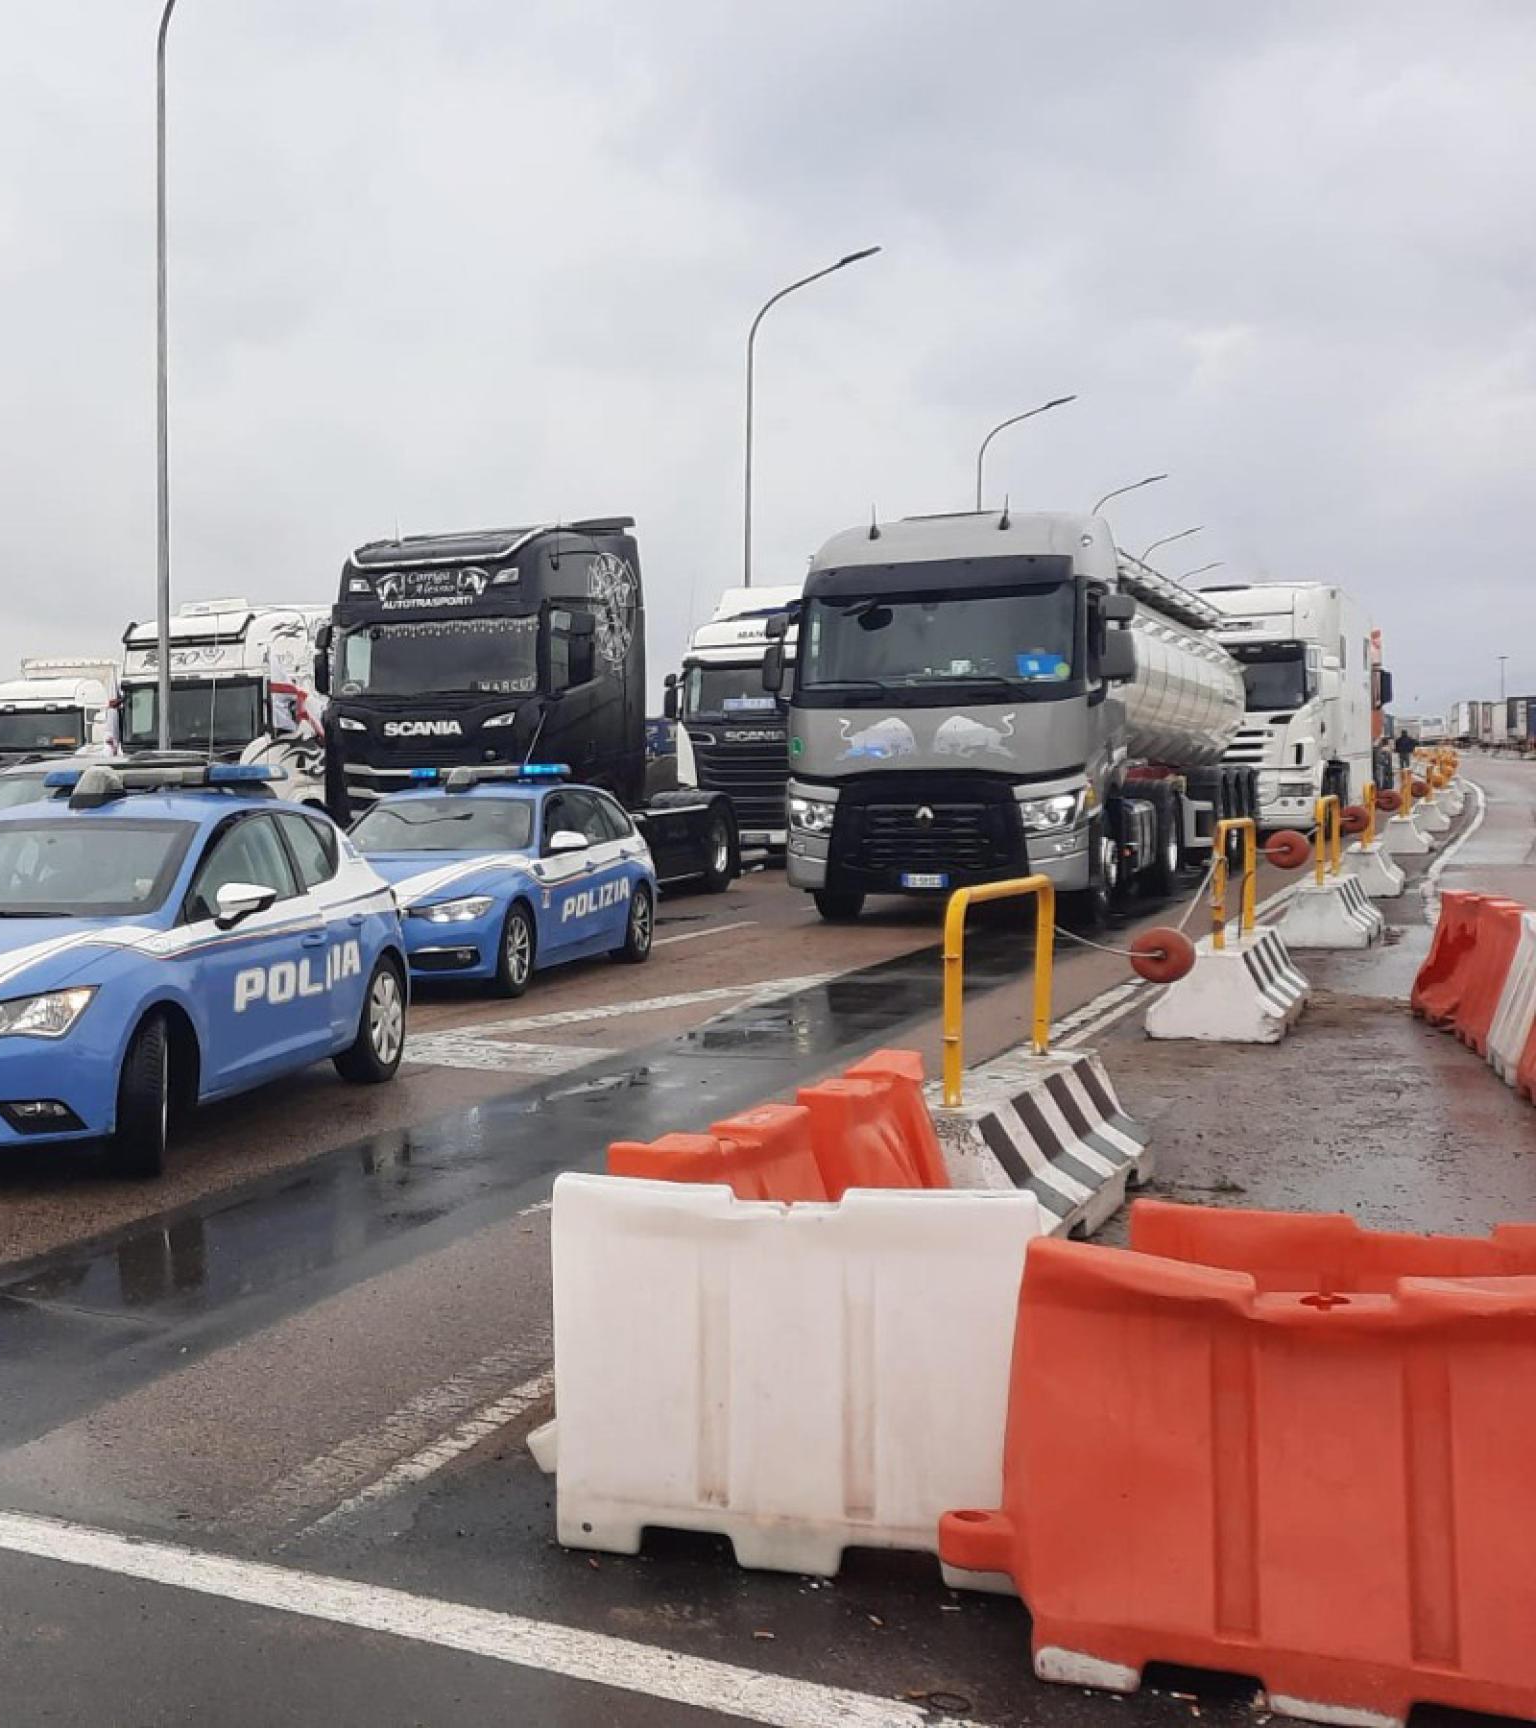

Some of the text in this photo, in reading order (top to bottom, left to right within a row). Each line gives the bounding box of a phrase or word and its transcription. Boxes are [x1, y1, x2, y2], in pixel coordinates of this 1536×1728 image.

[382, 595, 473, 610] AUTOTRASPORTI
[383, 720, 463, 736] SCANIA
[561, 877, 630, 922] POLIZIA
